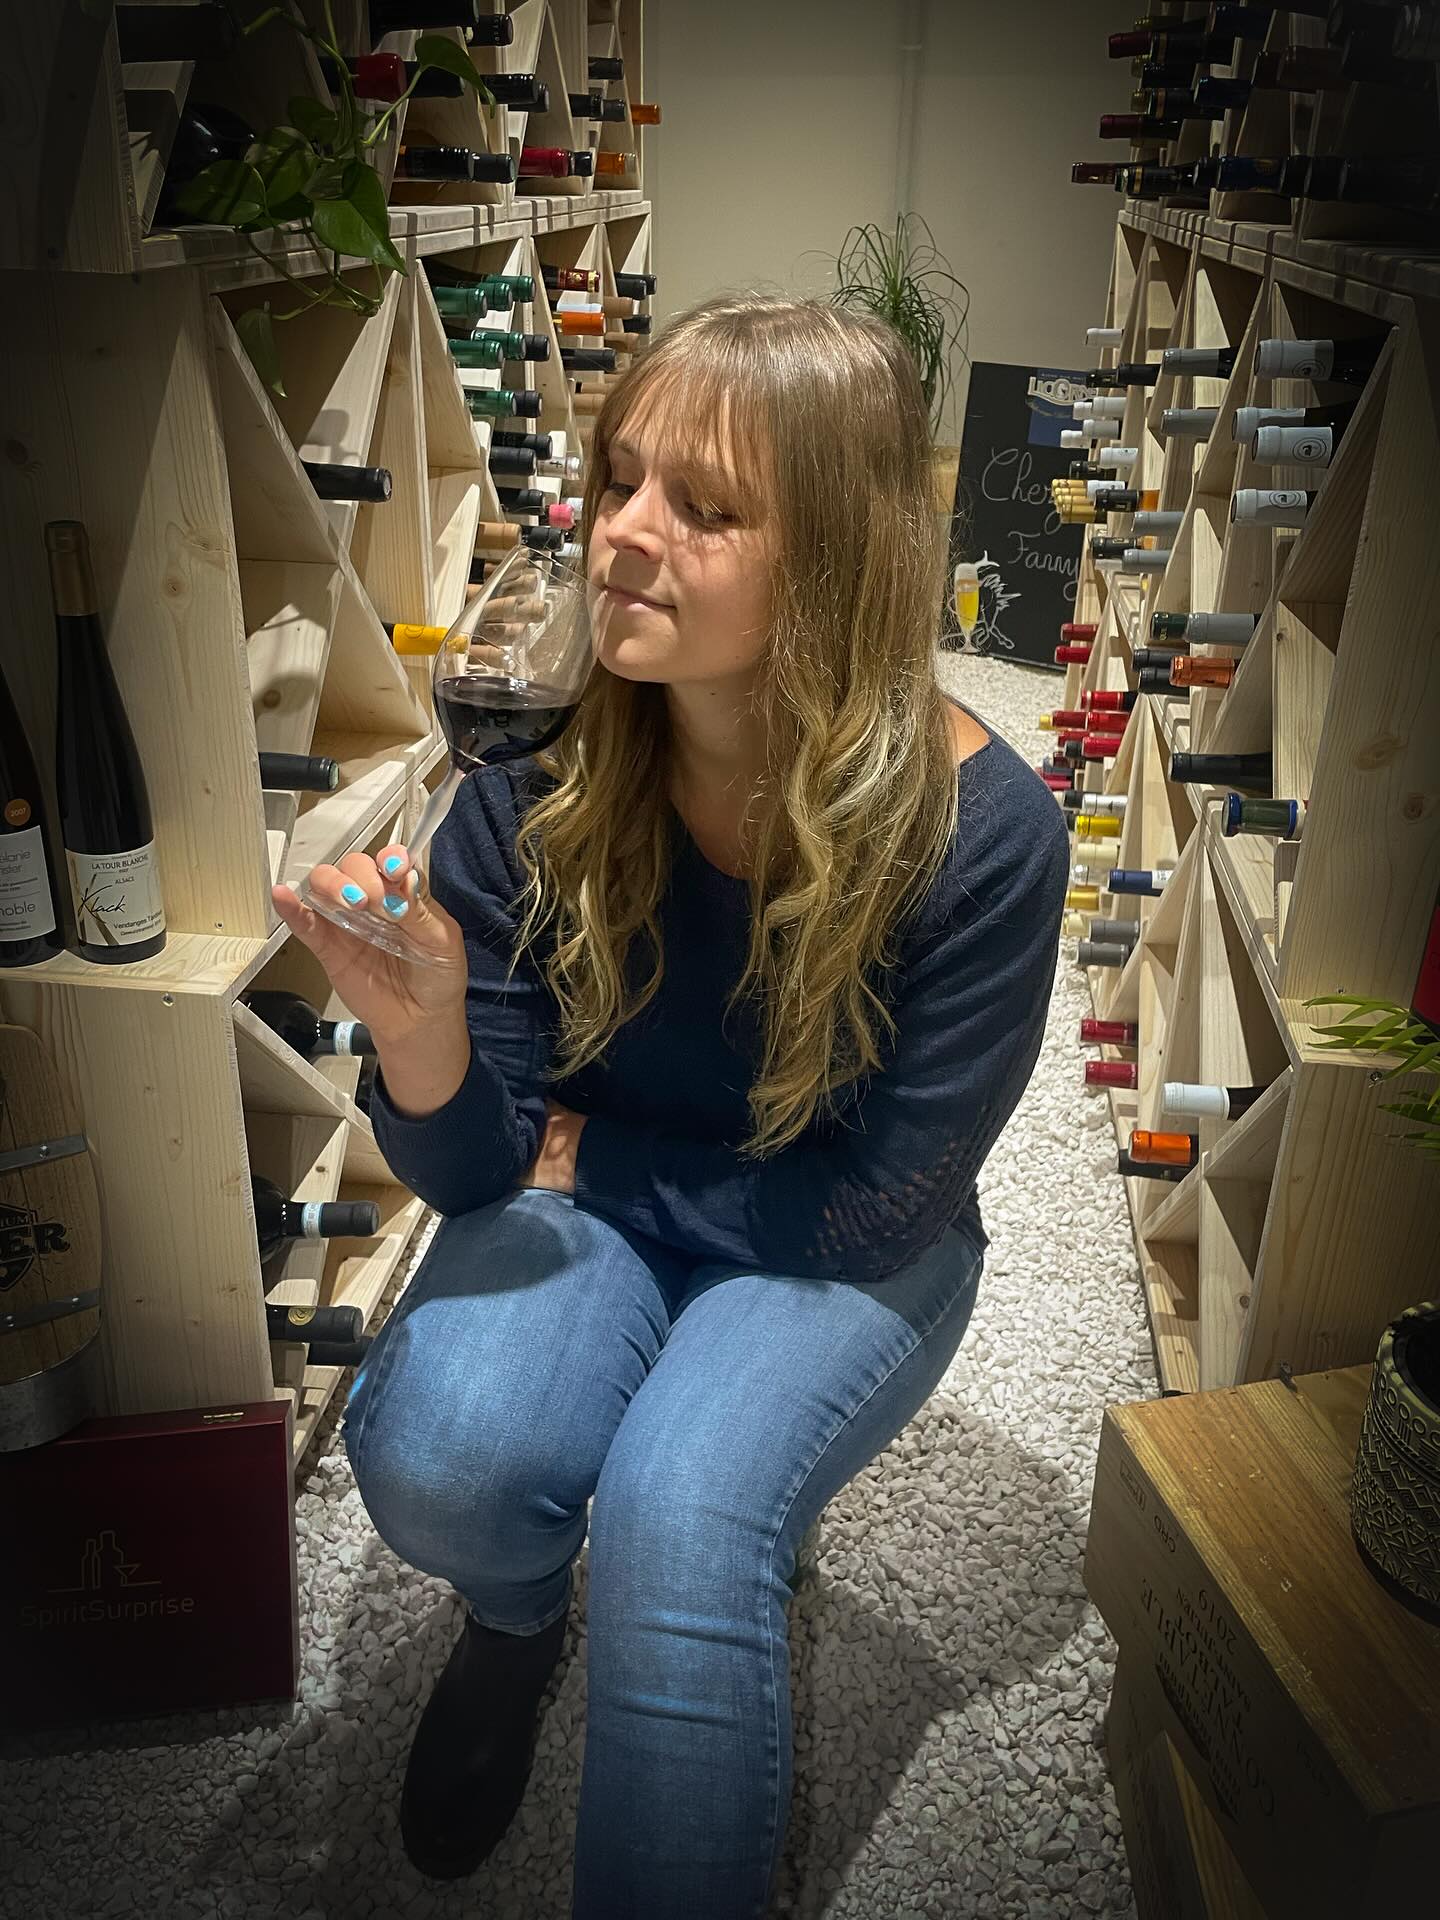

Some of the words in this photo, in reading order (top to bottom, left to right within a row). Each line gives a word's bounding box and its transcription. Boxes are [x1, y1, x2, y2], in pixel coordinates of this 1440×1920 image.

[10, 807, 26, 817] 2007
[101, 861, 121, 870] TOUR
[20, 1593, 197, 1631] SpiritSurprise
[1197, 1589, 1237, 1656] 2019
[1175, 1615, 1244, 1733] TALBOT
